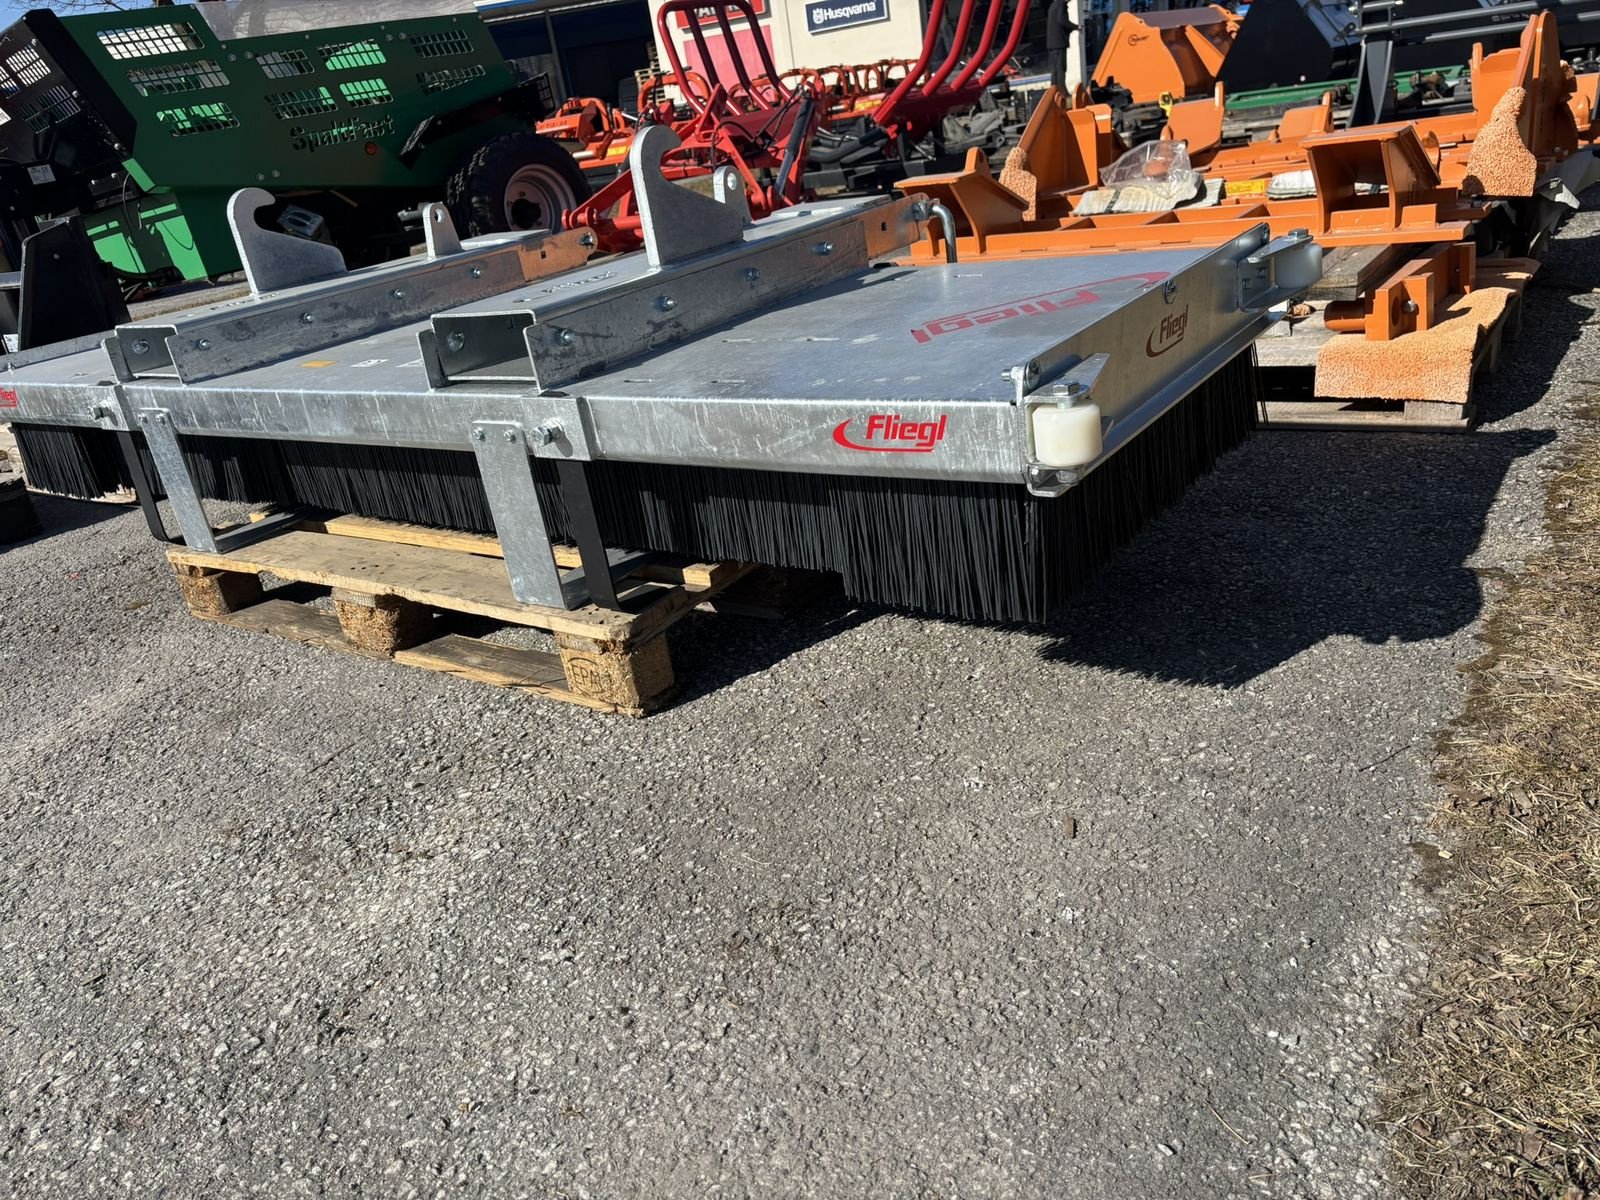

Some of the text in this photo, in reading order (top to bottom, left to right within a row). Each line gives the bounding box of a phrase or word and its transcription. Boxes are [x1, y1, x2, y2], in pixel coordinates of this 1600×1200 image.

[824, 1, 876, 20] Husqvarna
[911, 290, 1100, 343] Fliegl
[1159, 303, 1189, 344] Fliegl
[866, 414, 948, 447] Fliegl
